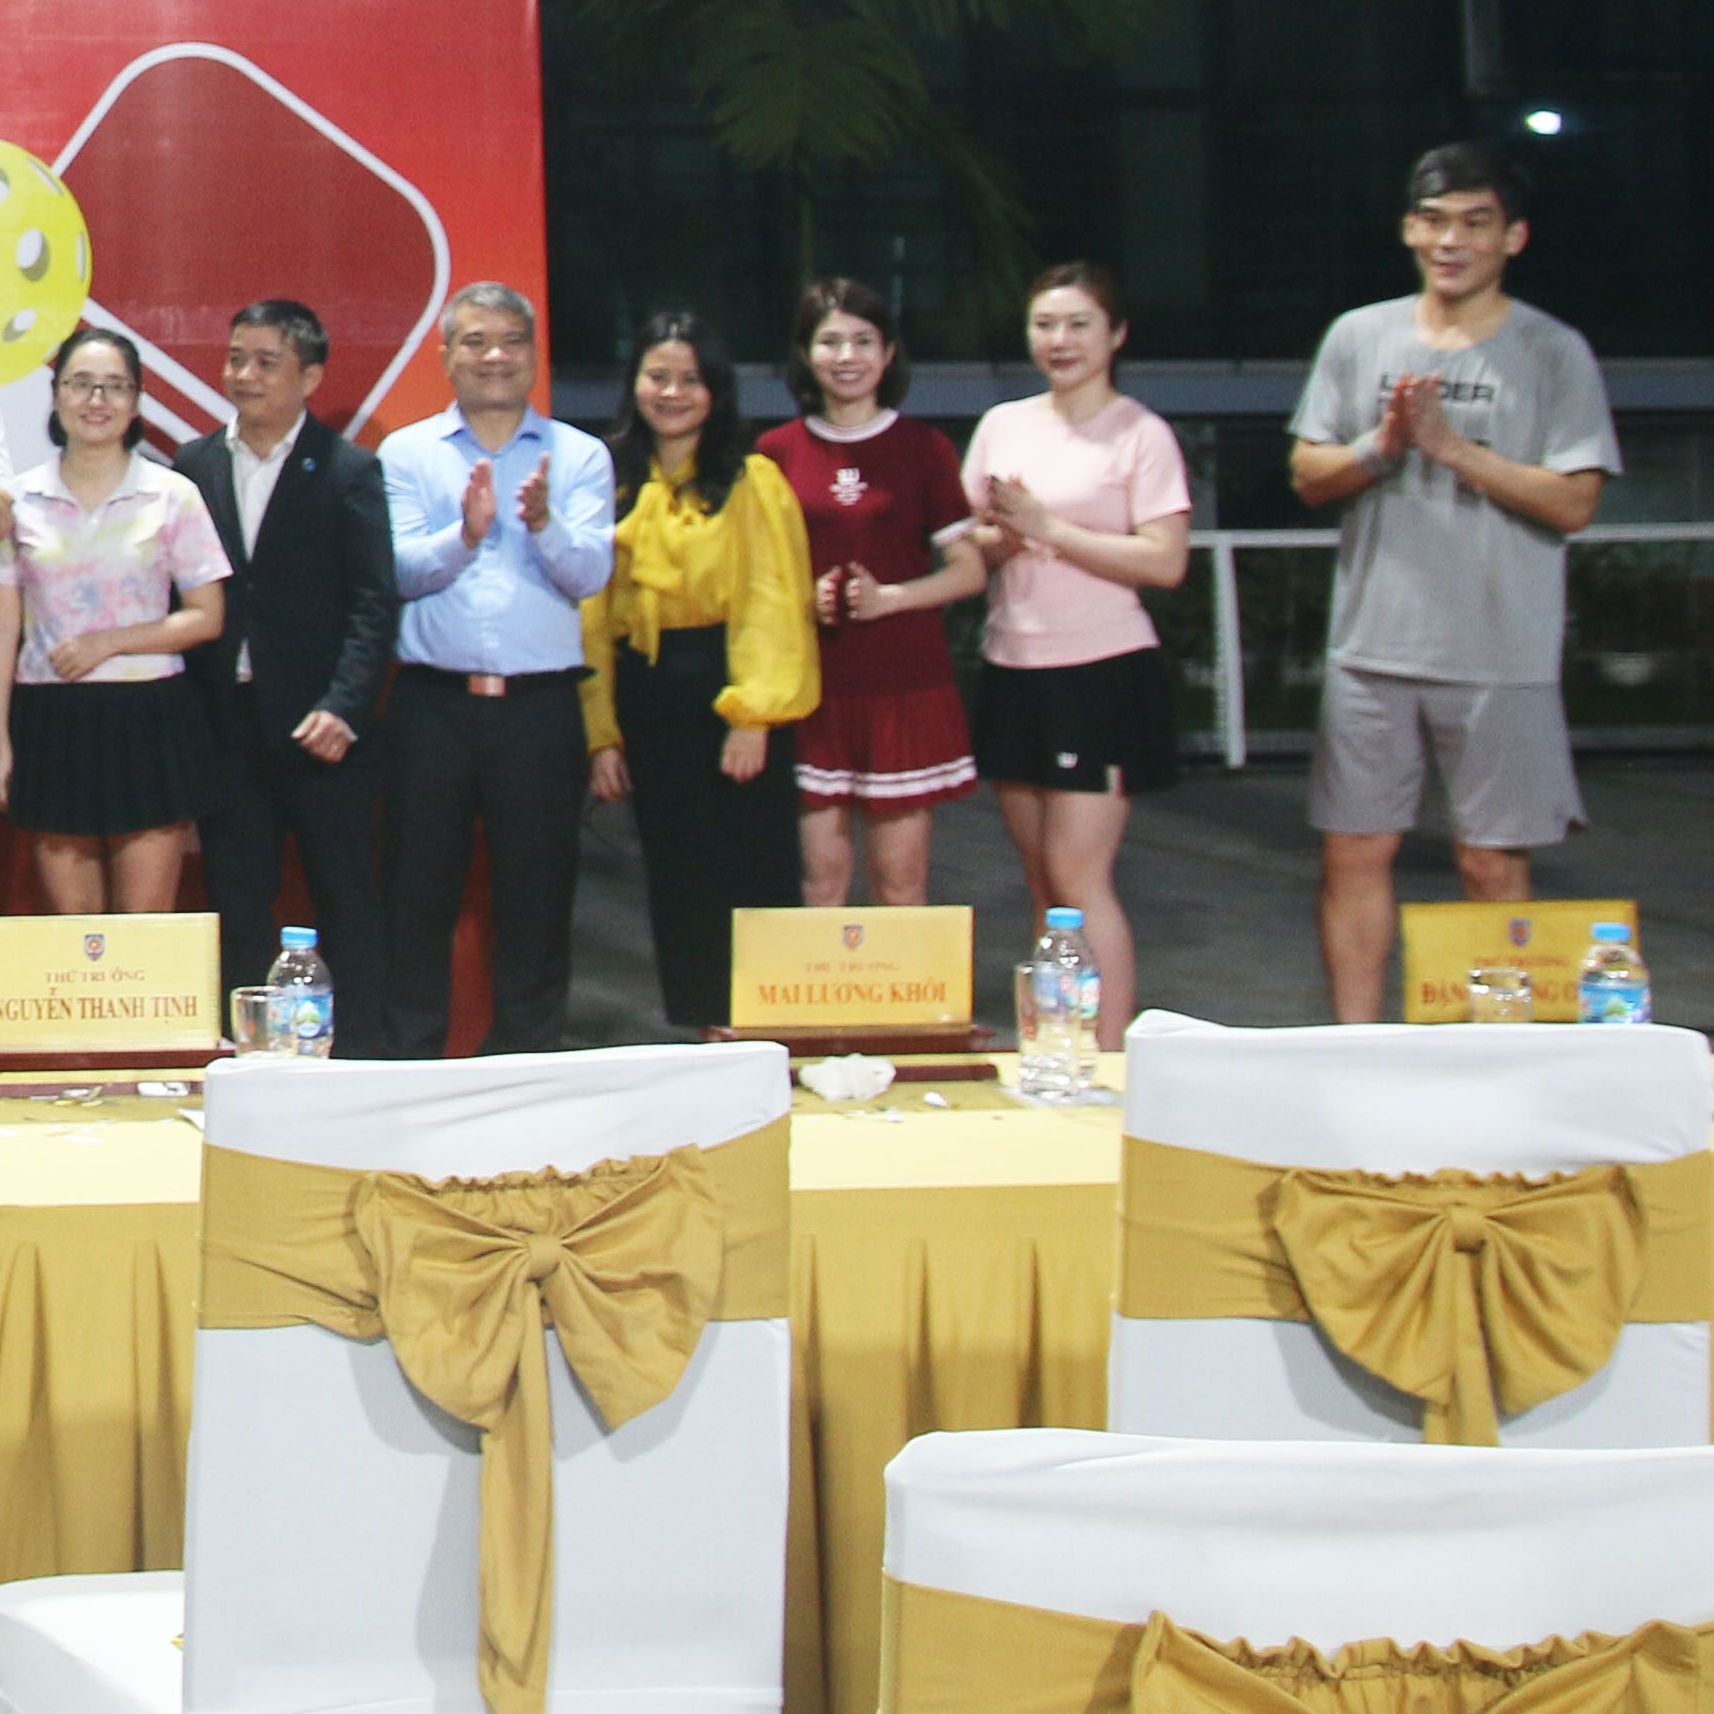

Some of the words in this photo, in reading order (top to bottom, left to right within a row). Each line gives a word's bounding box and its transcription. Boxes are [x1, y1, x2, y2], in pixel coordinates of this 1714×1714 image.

[757, 982, 803, 1006] MAI
[806, 980, 885, 1005] LƯƠNG
[76, 995, 146, 1021] THANH
[152, 994, 199, 1025] TỊNH
